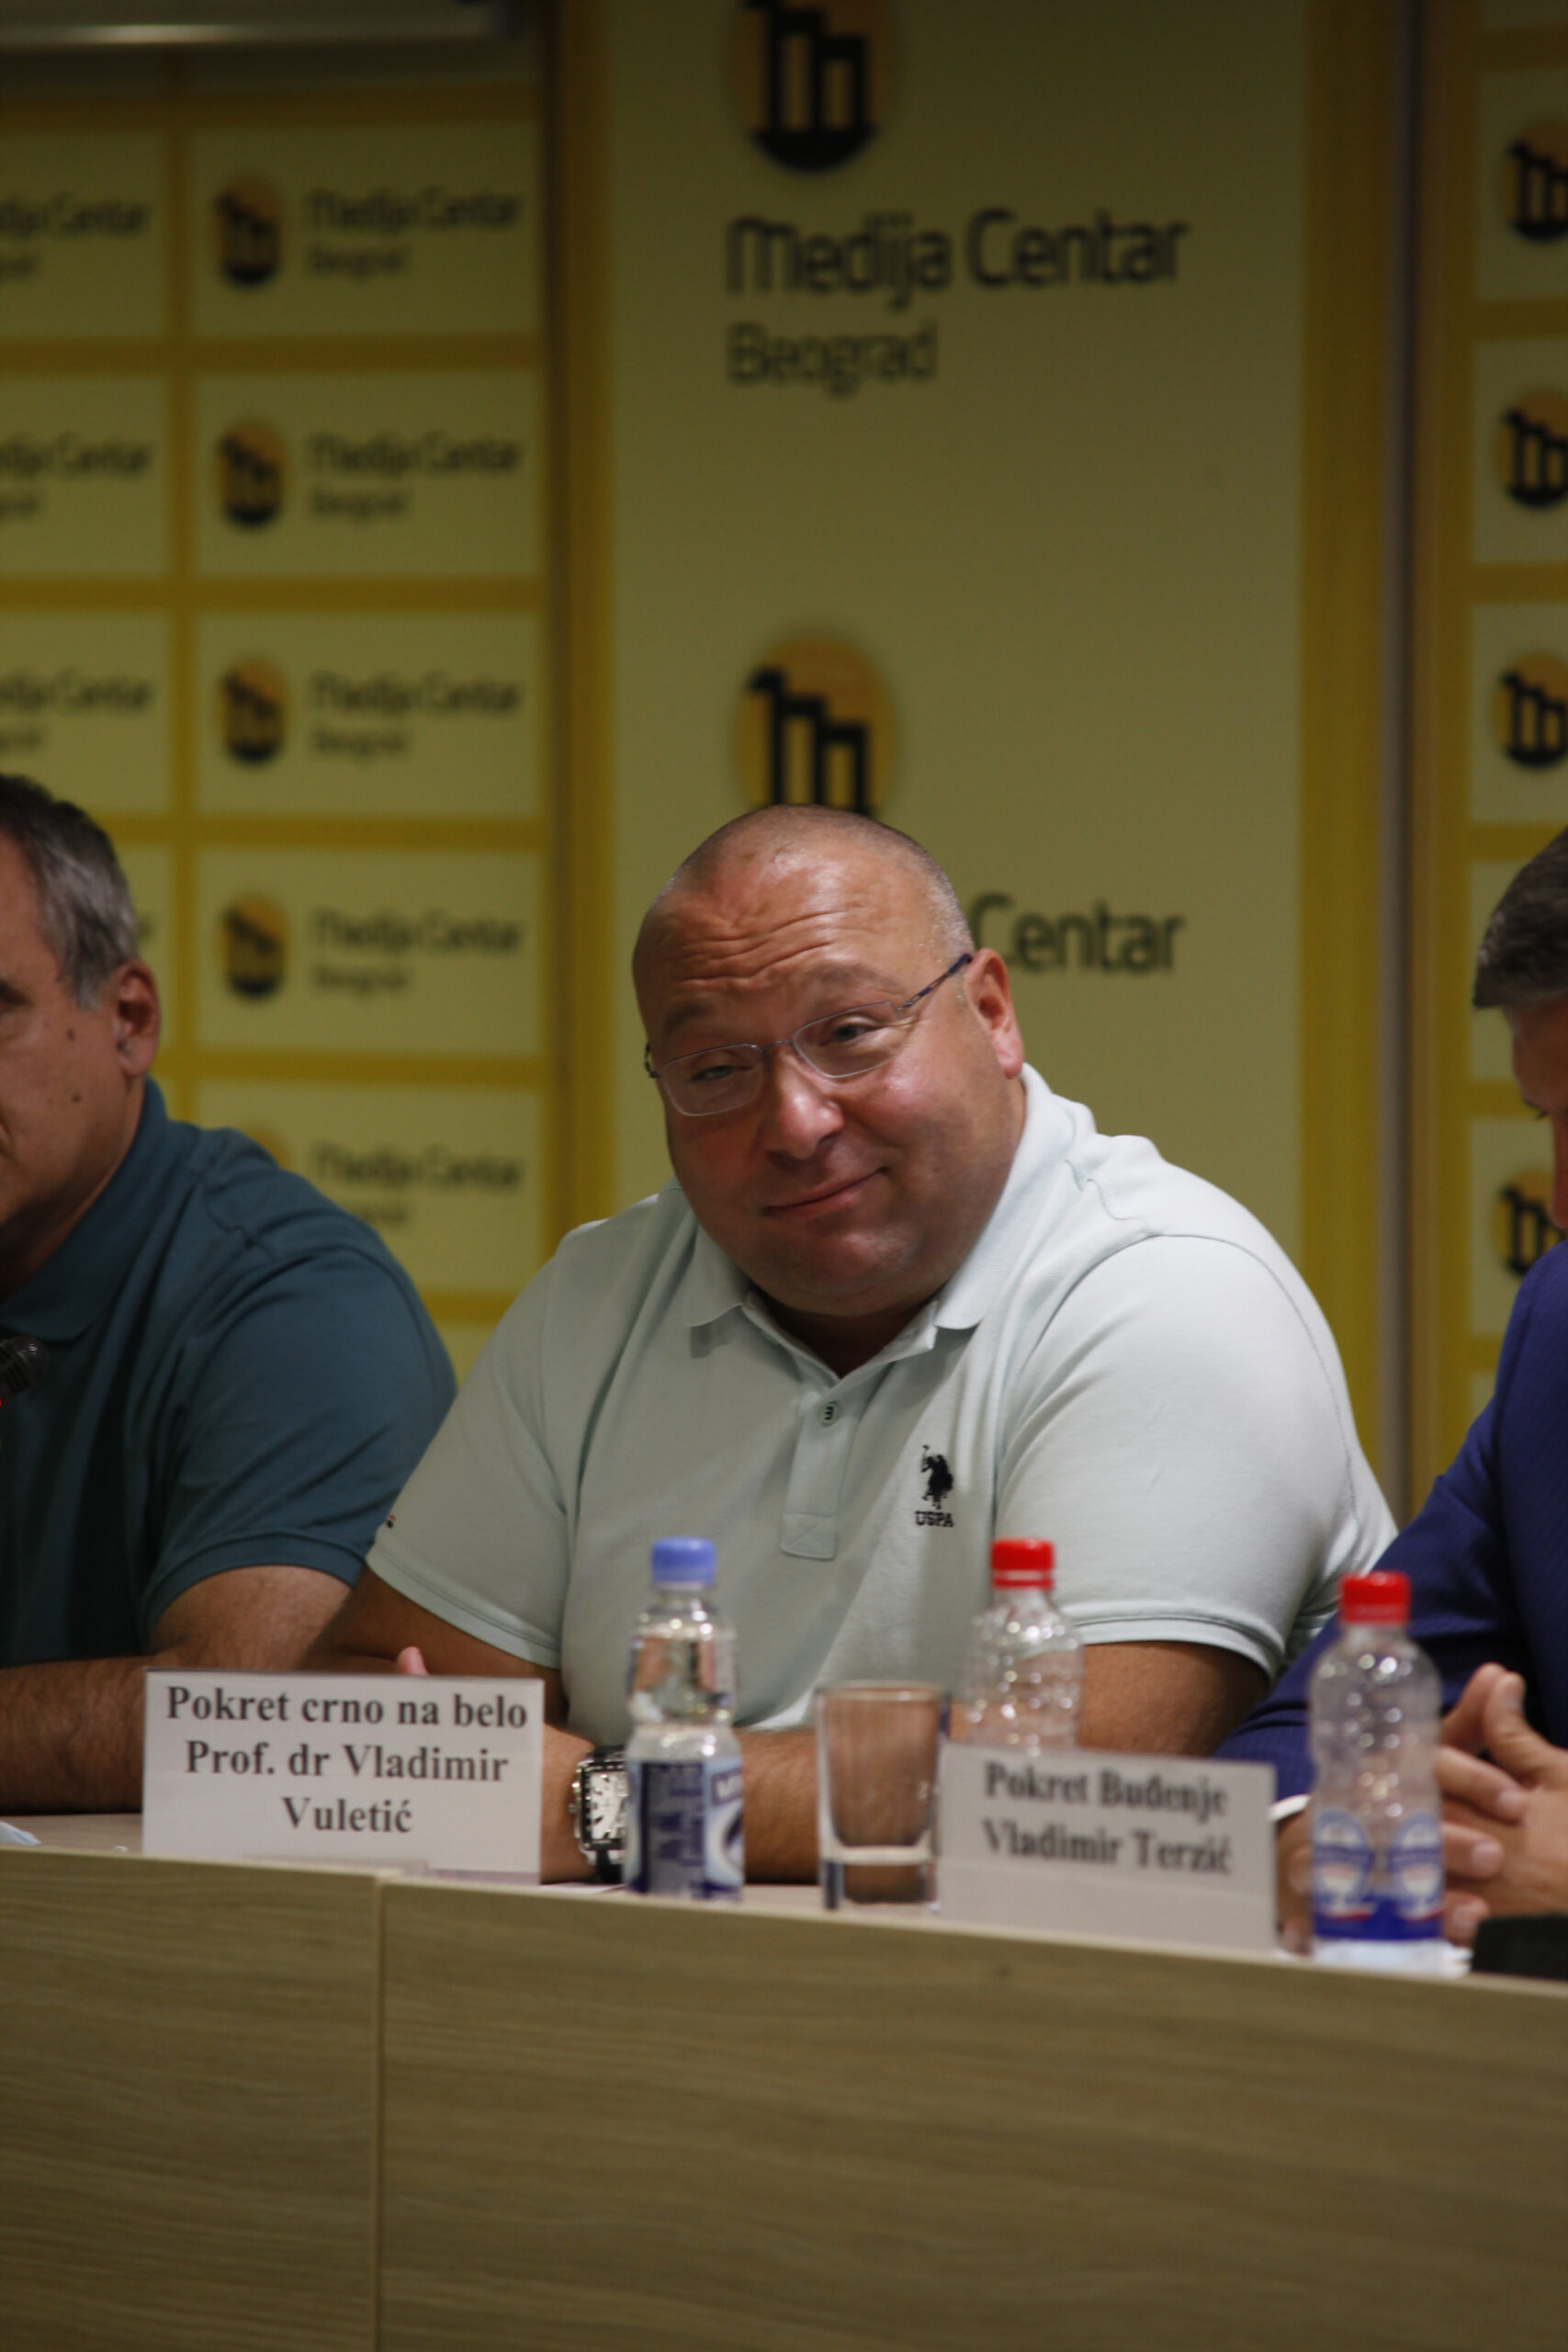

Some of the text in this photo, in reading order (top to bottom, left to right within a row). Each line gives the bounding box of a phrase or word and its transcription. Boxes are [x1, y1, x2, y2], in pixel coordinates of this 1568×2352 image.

[726, 206, 1190, 311] Medija Centar
[726, 320, 938, 398] Beograd
[967, 891, 1190, 974] Centar
[166, 1685, 528, 1729] Pokret crno na belo
[186, 1739, 509, 1782] Prof. dr Vladimir
[985, 1759, 1089, 1804] Pokret
[281, 1795, 412, 1834] Vuletić
[982, 1817, 1231, 1874] Vladimir Terzić
